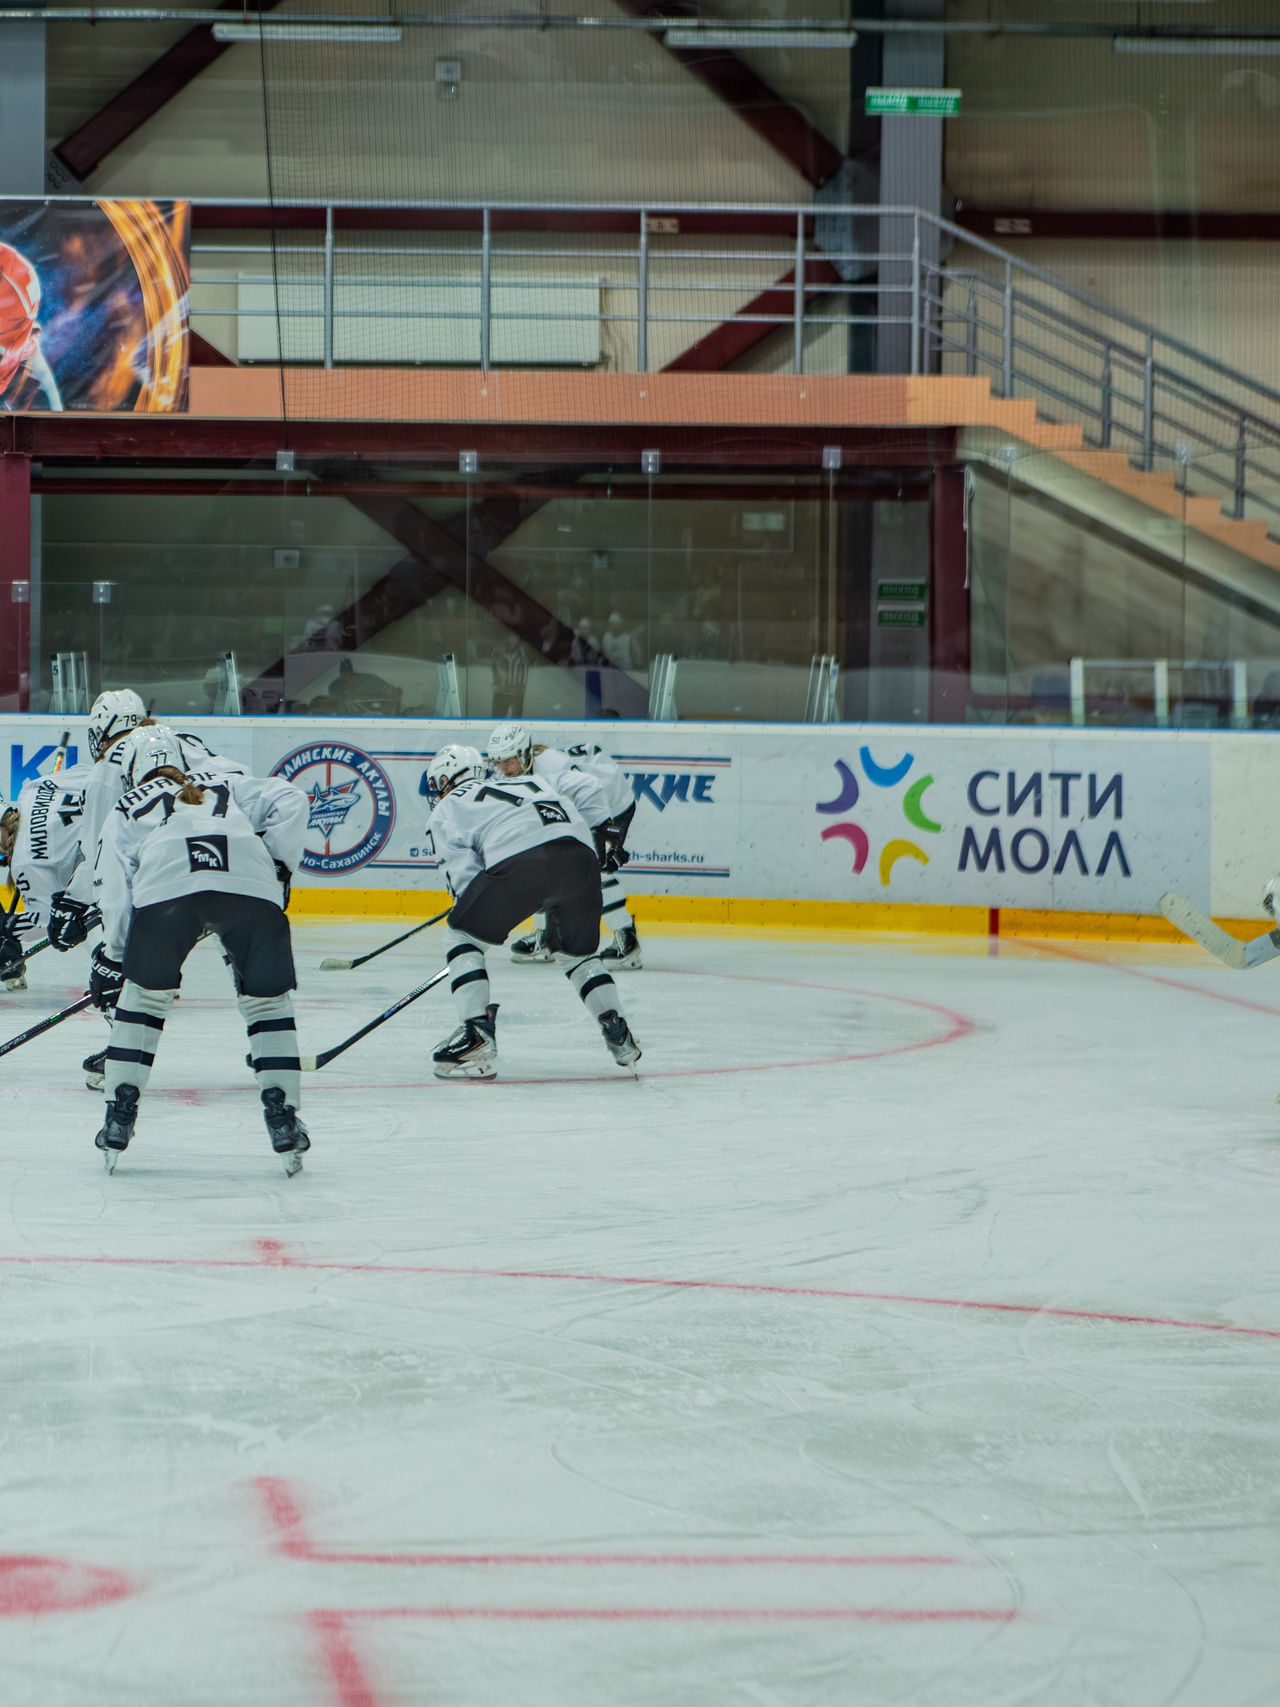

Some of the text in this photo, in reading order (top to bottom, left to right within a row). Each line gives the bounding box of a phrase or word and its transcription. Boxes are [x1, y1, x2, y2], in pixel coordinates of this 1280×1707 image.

[123, 714, 138, 728] 79
[150, 752, 168, 767] 77
[472, 765, 483, 778] 17
[356, 761, 391, 816] АКУЛЫ
[623, 772, 716, 813] КИЕ
[966, 769, 1124, 820] СИТИ
[191, 850, 218, 868] ТМК
[299, 831, 382, 870] но-Сахалинск
[627, 850, 705, 863] kh-sharks.ru
[956, 825, 1132, 879] МОЛЛ
[92, 960, 123, 981] UER
